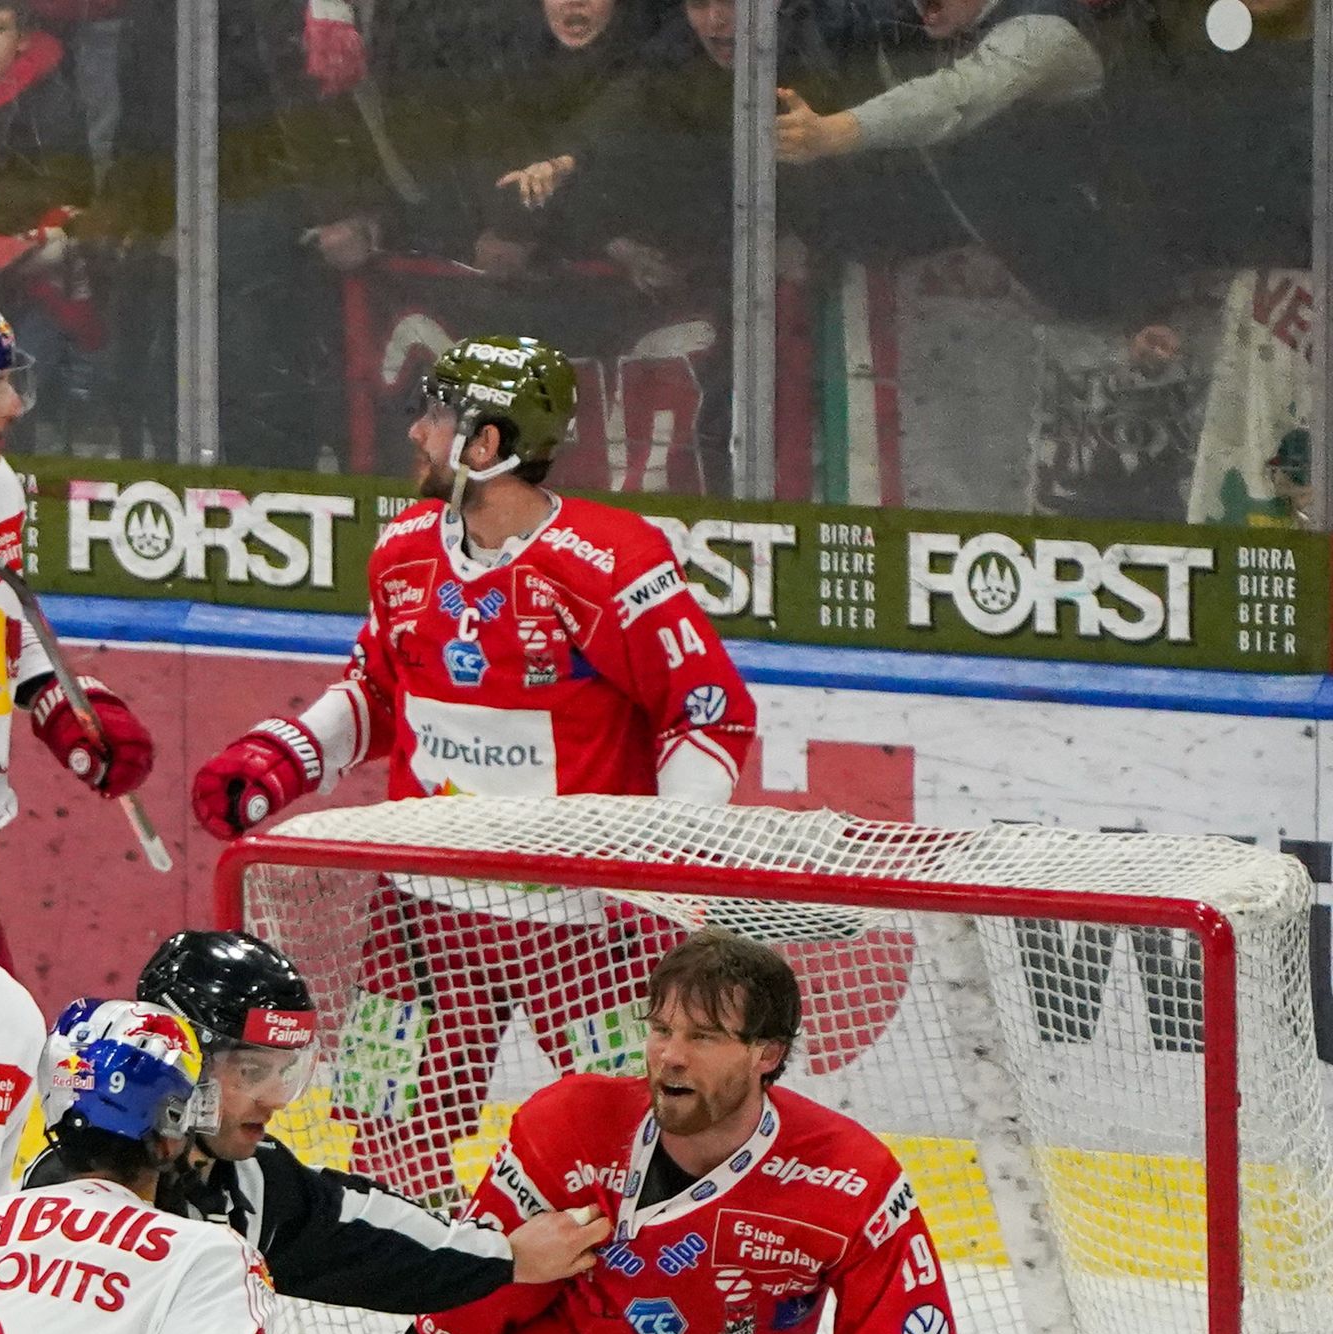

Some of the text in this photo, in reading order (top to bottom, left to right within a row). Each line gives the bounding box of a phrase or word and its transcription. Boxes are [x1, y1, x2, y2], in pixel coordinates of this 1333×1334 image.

[466, 343, 535, 369] FORST
[467, 382, 518, 407] FORST
[68, 480, 355, 588] FORST
[819, 522, 875, 547] BIRRA
[540, 526, 616, 574] alperia
[1238, 546, 1297, 572] BIRRA
[819, 578, 875, 603] BEER
[908, 532, 1214, 643] FORST
[458, 607, 481, 642] C
[819, 605, 875, 630] BIER
[1238, 602, 1297, 626] BEER
[658, 618, 706, 669] 94
[1238, 629, 1297, 655] BIER
[267, 1026, 312, 1044] Fairplay
[108, 1070, 126, 1095] 9
[761, 1154, 869, 1198] alperia
[754, 1226, 786, 1246] lebe
[656, 1231, 708, 1276] elpo
[739, 1239, 824, 1273] Fairplay
[903, 1232, 938, 1293] 19
